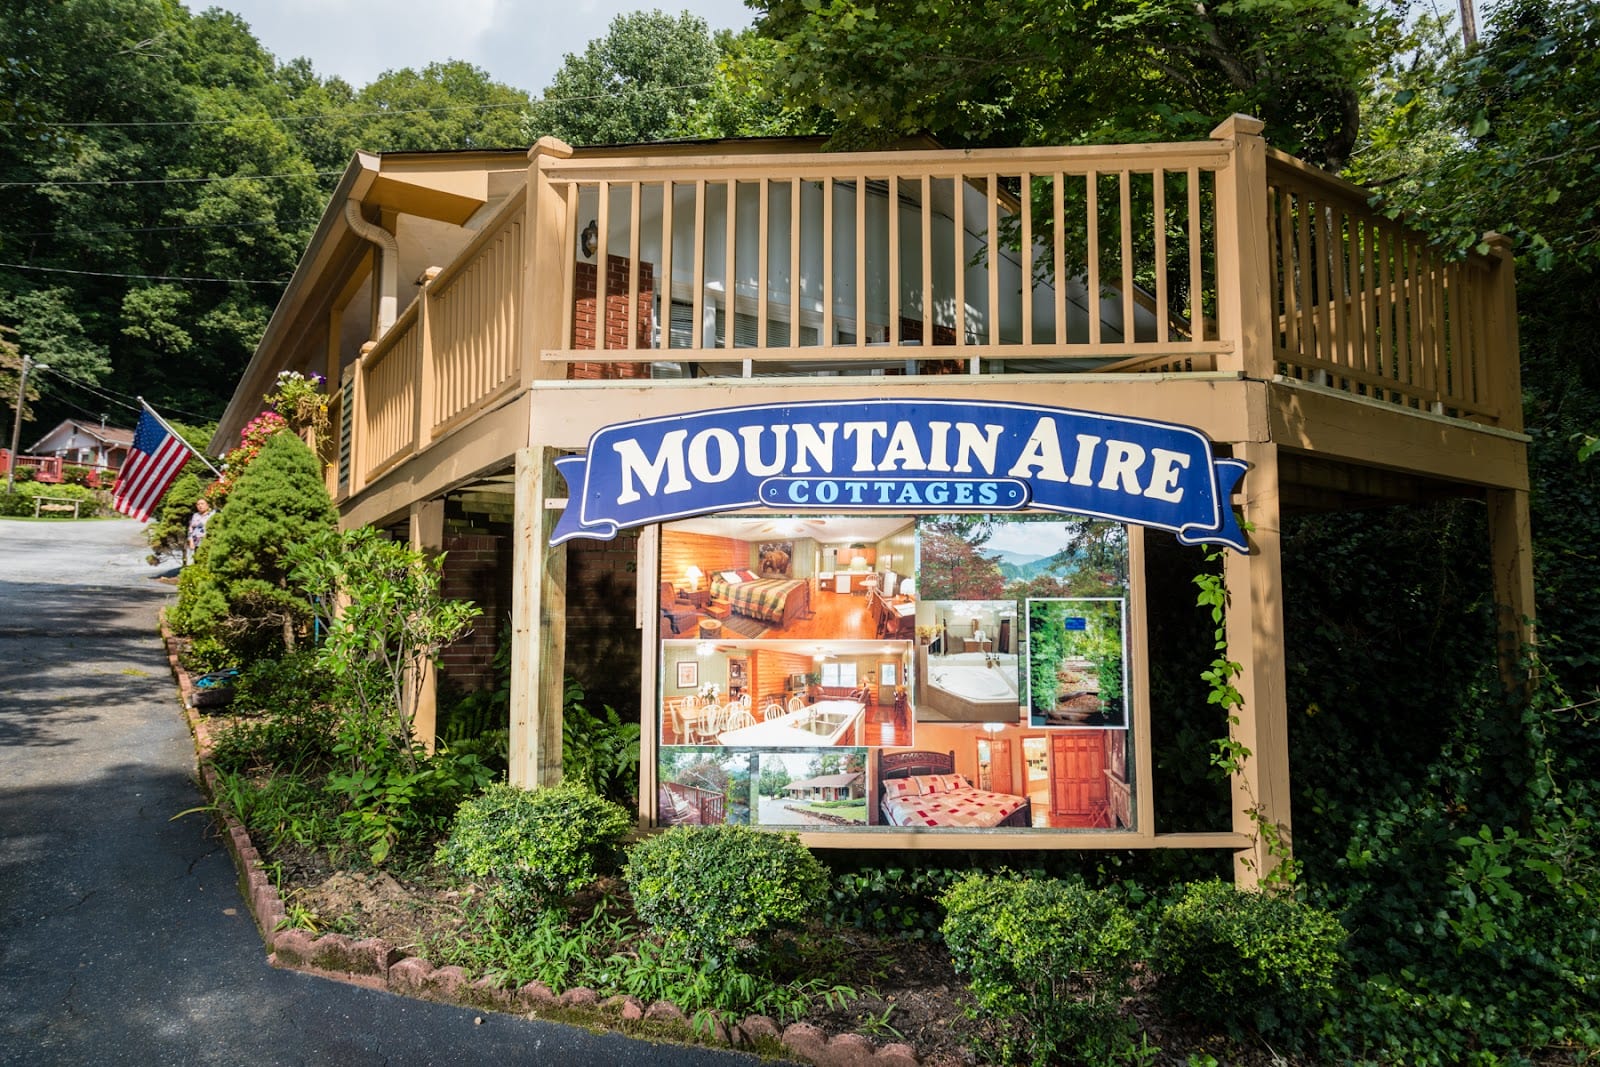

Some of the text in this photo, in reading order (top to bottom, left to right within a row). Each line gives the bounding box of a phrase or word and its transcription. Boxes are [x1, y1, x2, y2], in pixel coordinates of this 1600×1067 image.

[612, 416, 1191, 505] MOUNTAIN AIRE
[788, 480, 998, 505] COTTAGES
